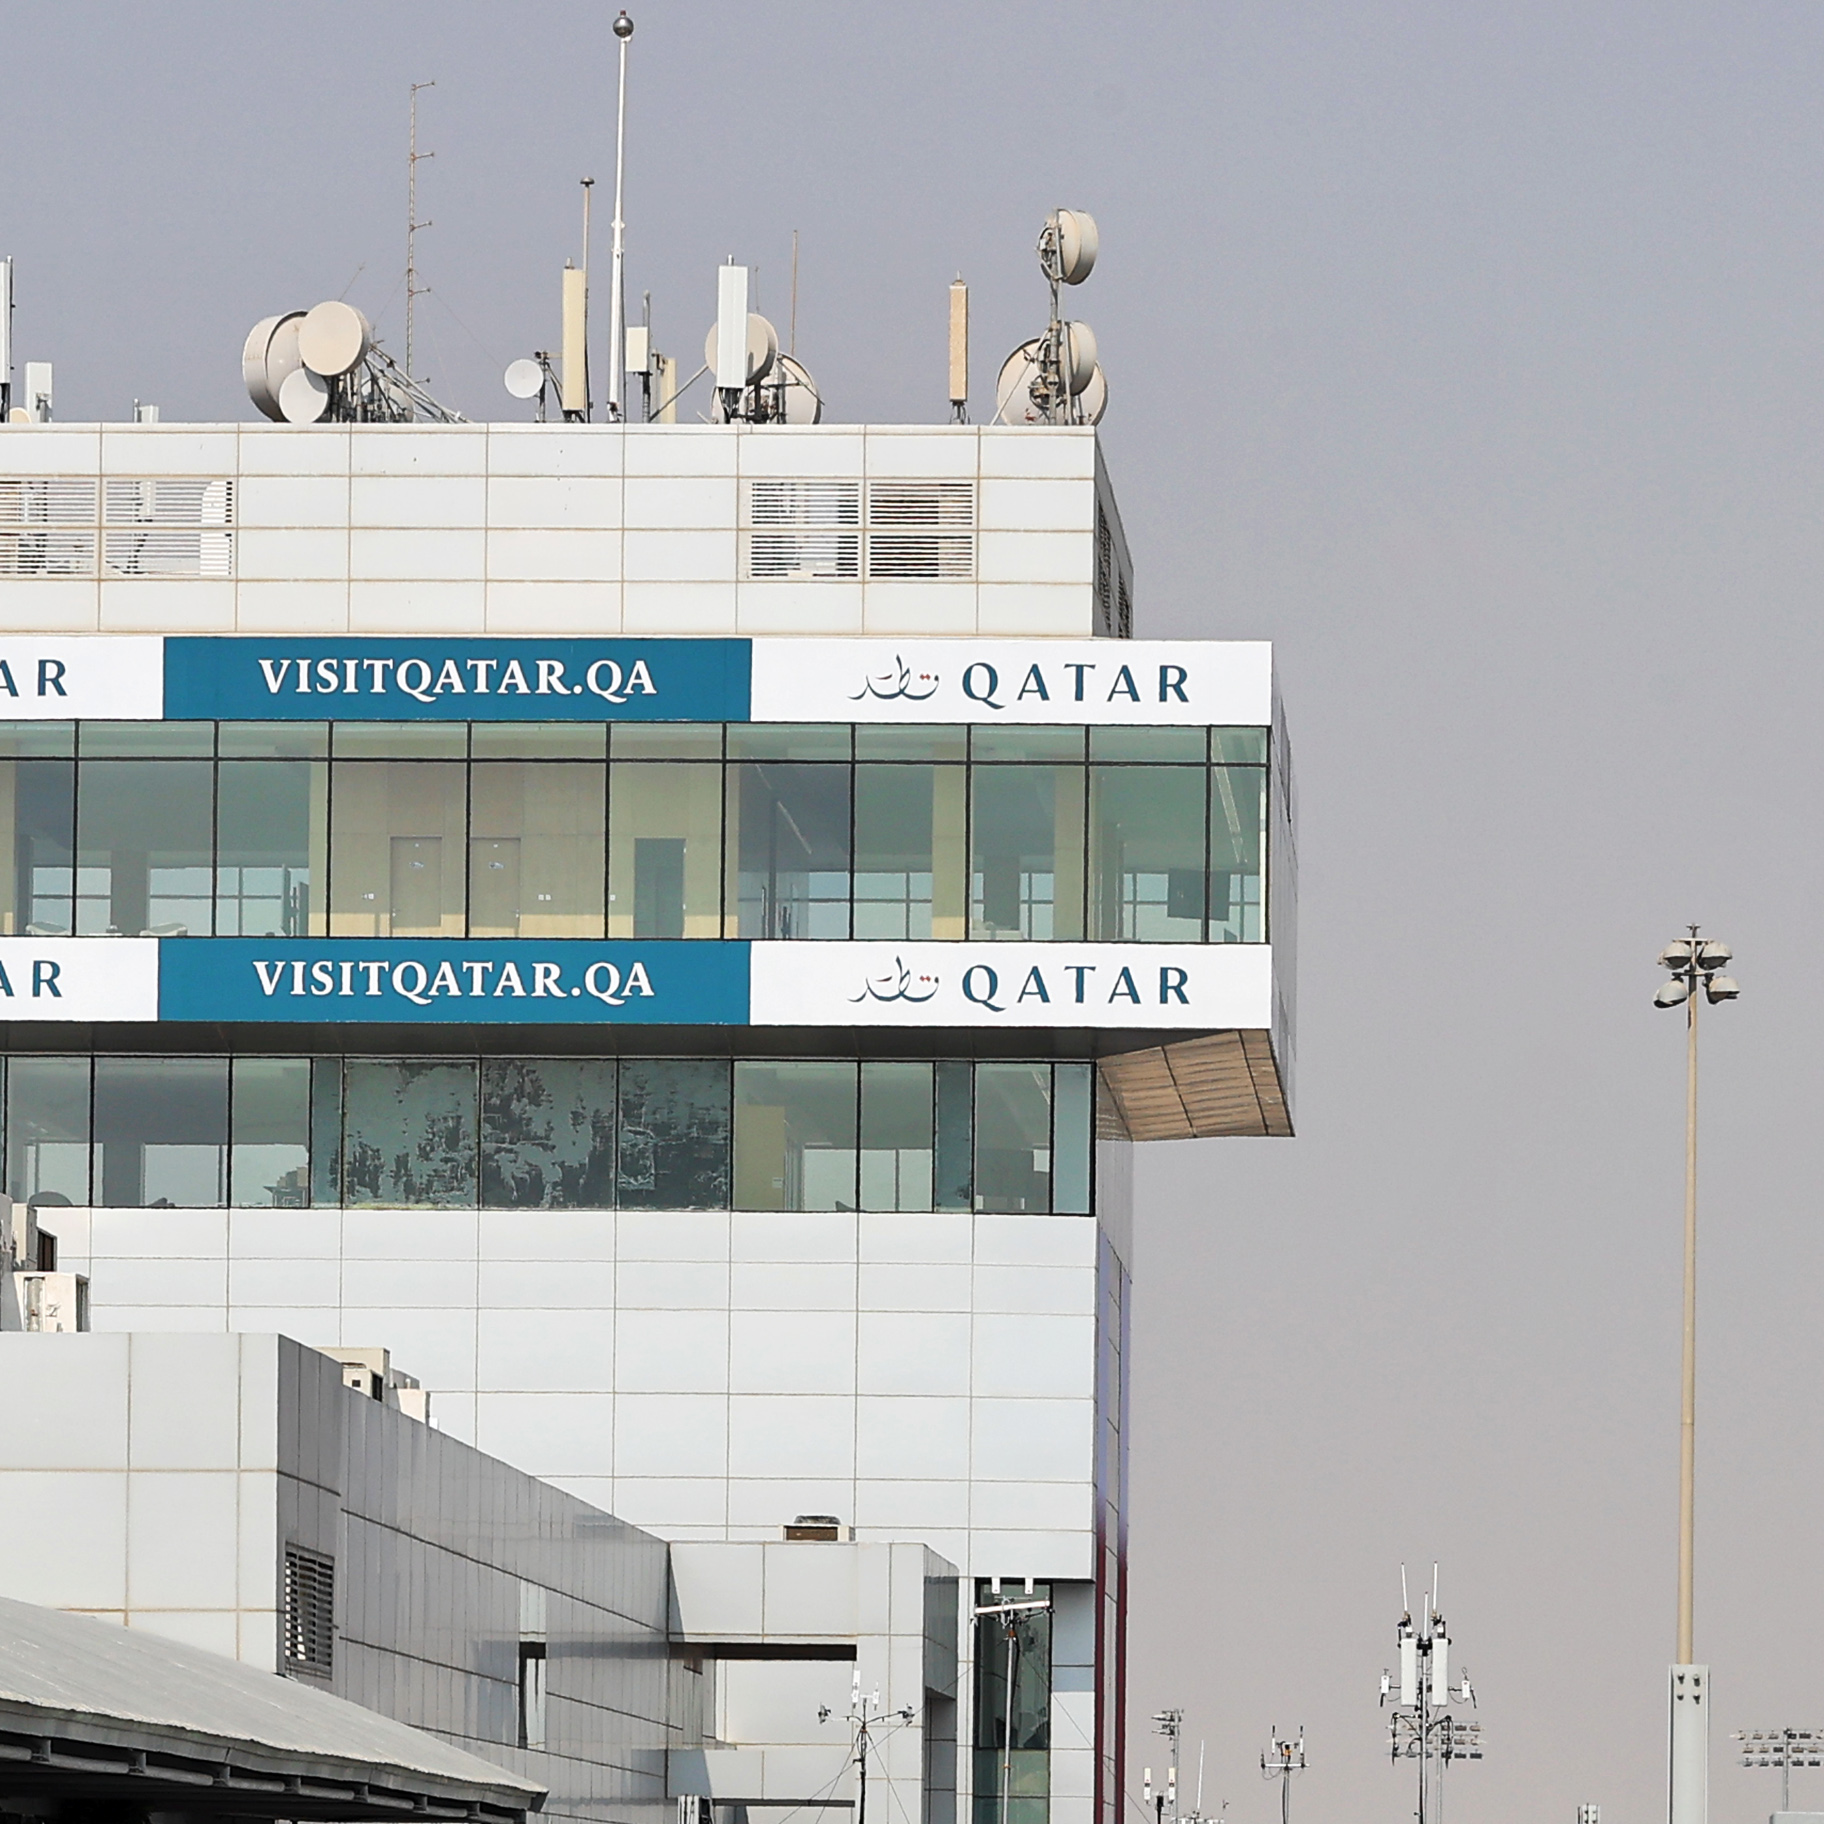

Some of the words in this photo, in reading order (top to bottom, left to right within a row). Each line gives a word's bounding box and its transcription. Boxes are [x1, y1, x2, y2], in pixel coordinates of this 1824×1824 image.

[258, 658, 657, 703] VISITQATAR.QA
[961, 661, 1191, 710] QATAR
[253, 960, 655, 1006] VISITQATAR.QA
[961, 964, 1191, 1013] QATAR
